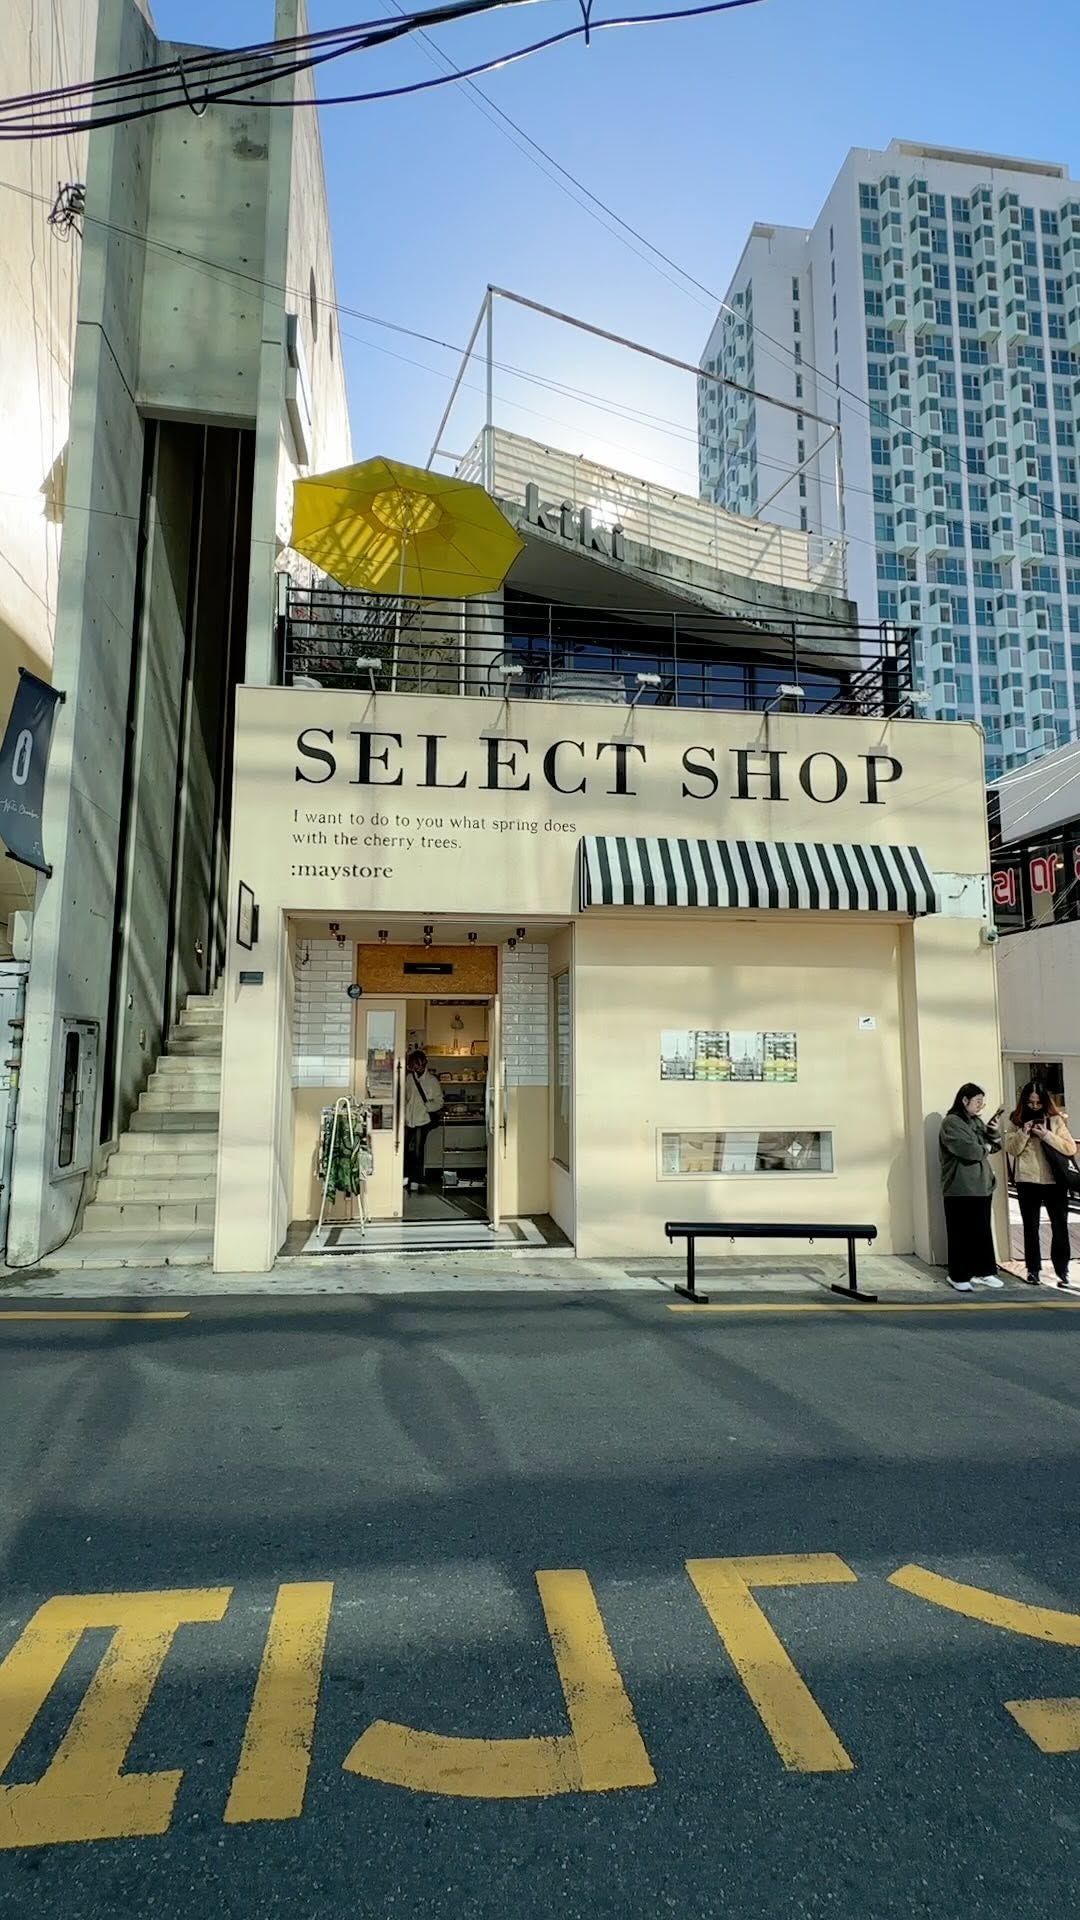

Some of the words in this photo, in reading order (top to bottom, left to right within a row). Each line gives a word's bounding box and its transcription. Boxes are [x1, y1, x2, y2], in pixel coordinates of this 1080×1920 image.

[525, 481, 625, 562] kiki
[295, 728, 647, 796] SELECT
[682, 746, 903, 805] SHOP
[293, 808, 299, 823] I
[305, 812, 343, 825] want
[349, 813, 366, 826] to
[370, 812, 390, 827] do
[395, 814, 411, 827] to
[416, 817, 444, 831] you
[449, 815, 486, 830] what
[492, 818, 539, 834] spring
[543, 818, 577, 833] does
[292, 831, 328, 845] with
[333, 831, 359, 846] the
[363, 833, 415, 851] cherry
[421, 836, 462, 849] trees.
[290, 863, 394, 881] :maystore
